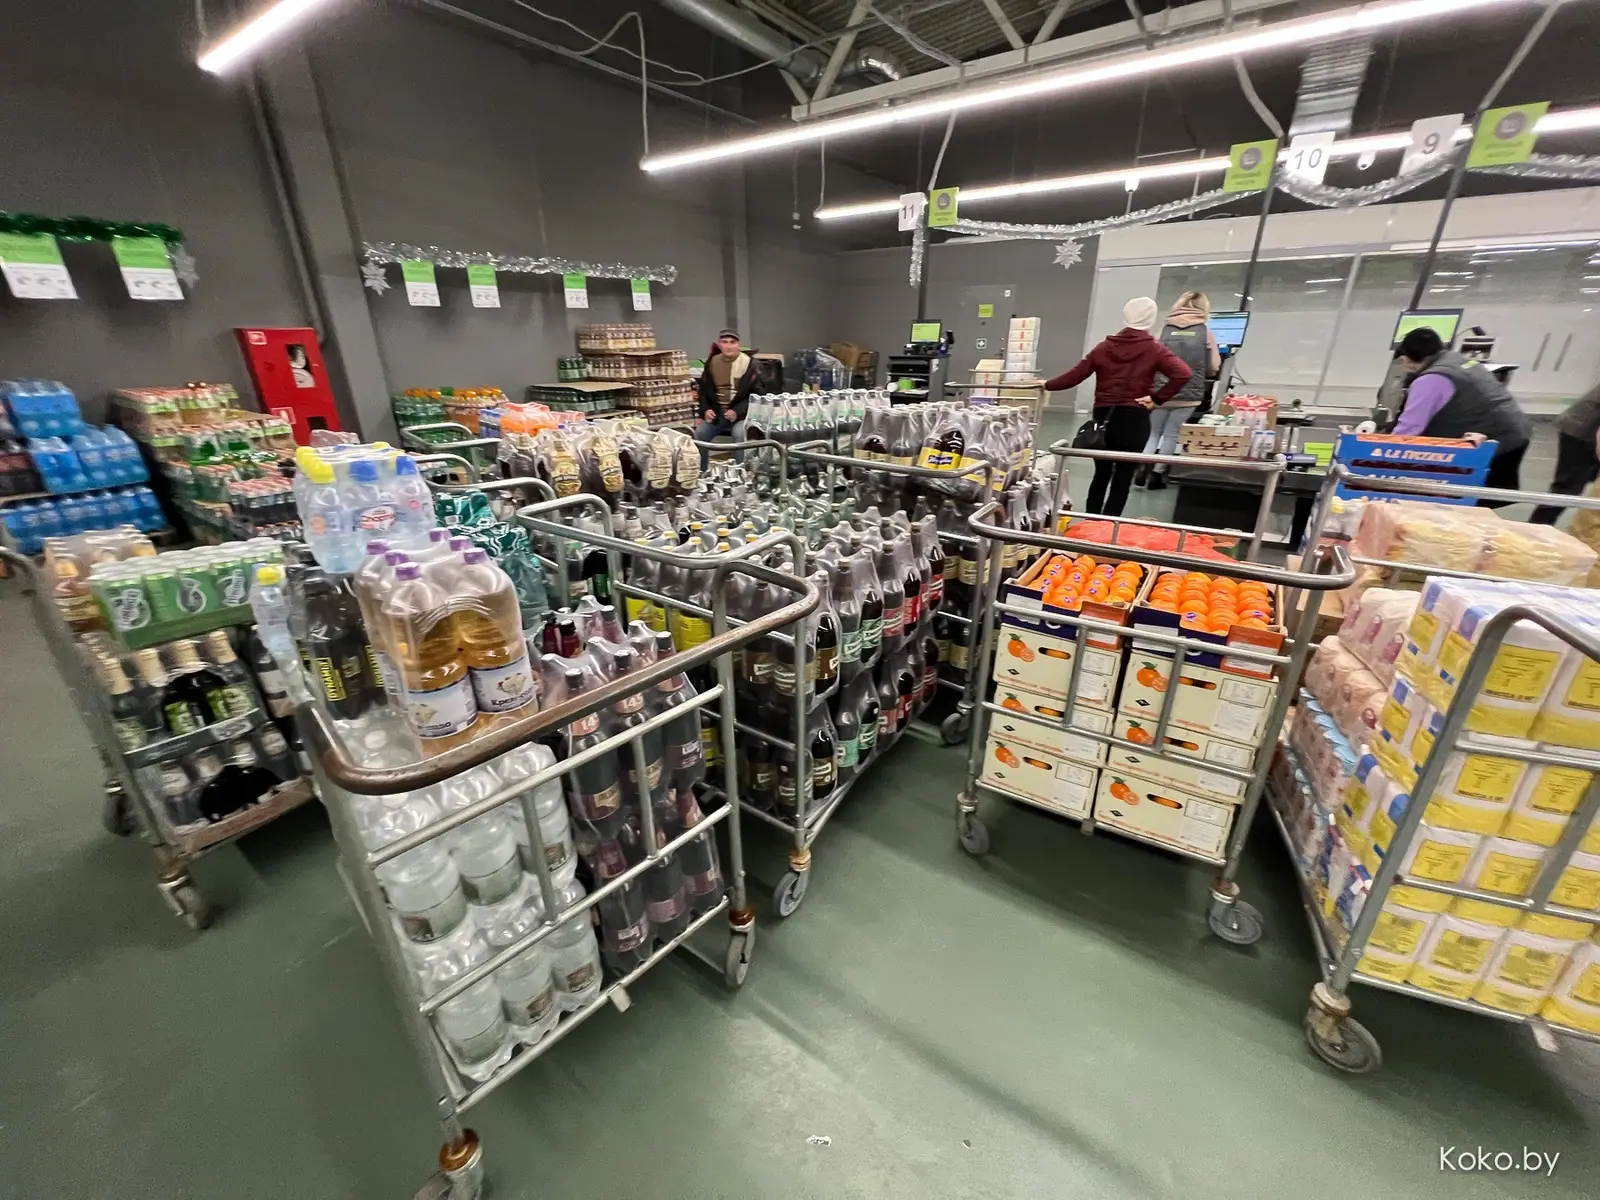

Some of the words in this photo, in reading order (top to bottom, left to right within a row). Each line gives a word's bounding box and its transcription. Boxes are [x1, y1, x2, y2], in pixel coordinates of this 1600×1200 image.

[1422, 132, 1441, 155] 9
[1294, 147, 1323, 170] 10
[901, 204, 915, 219] 11
